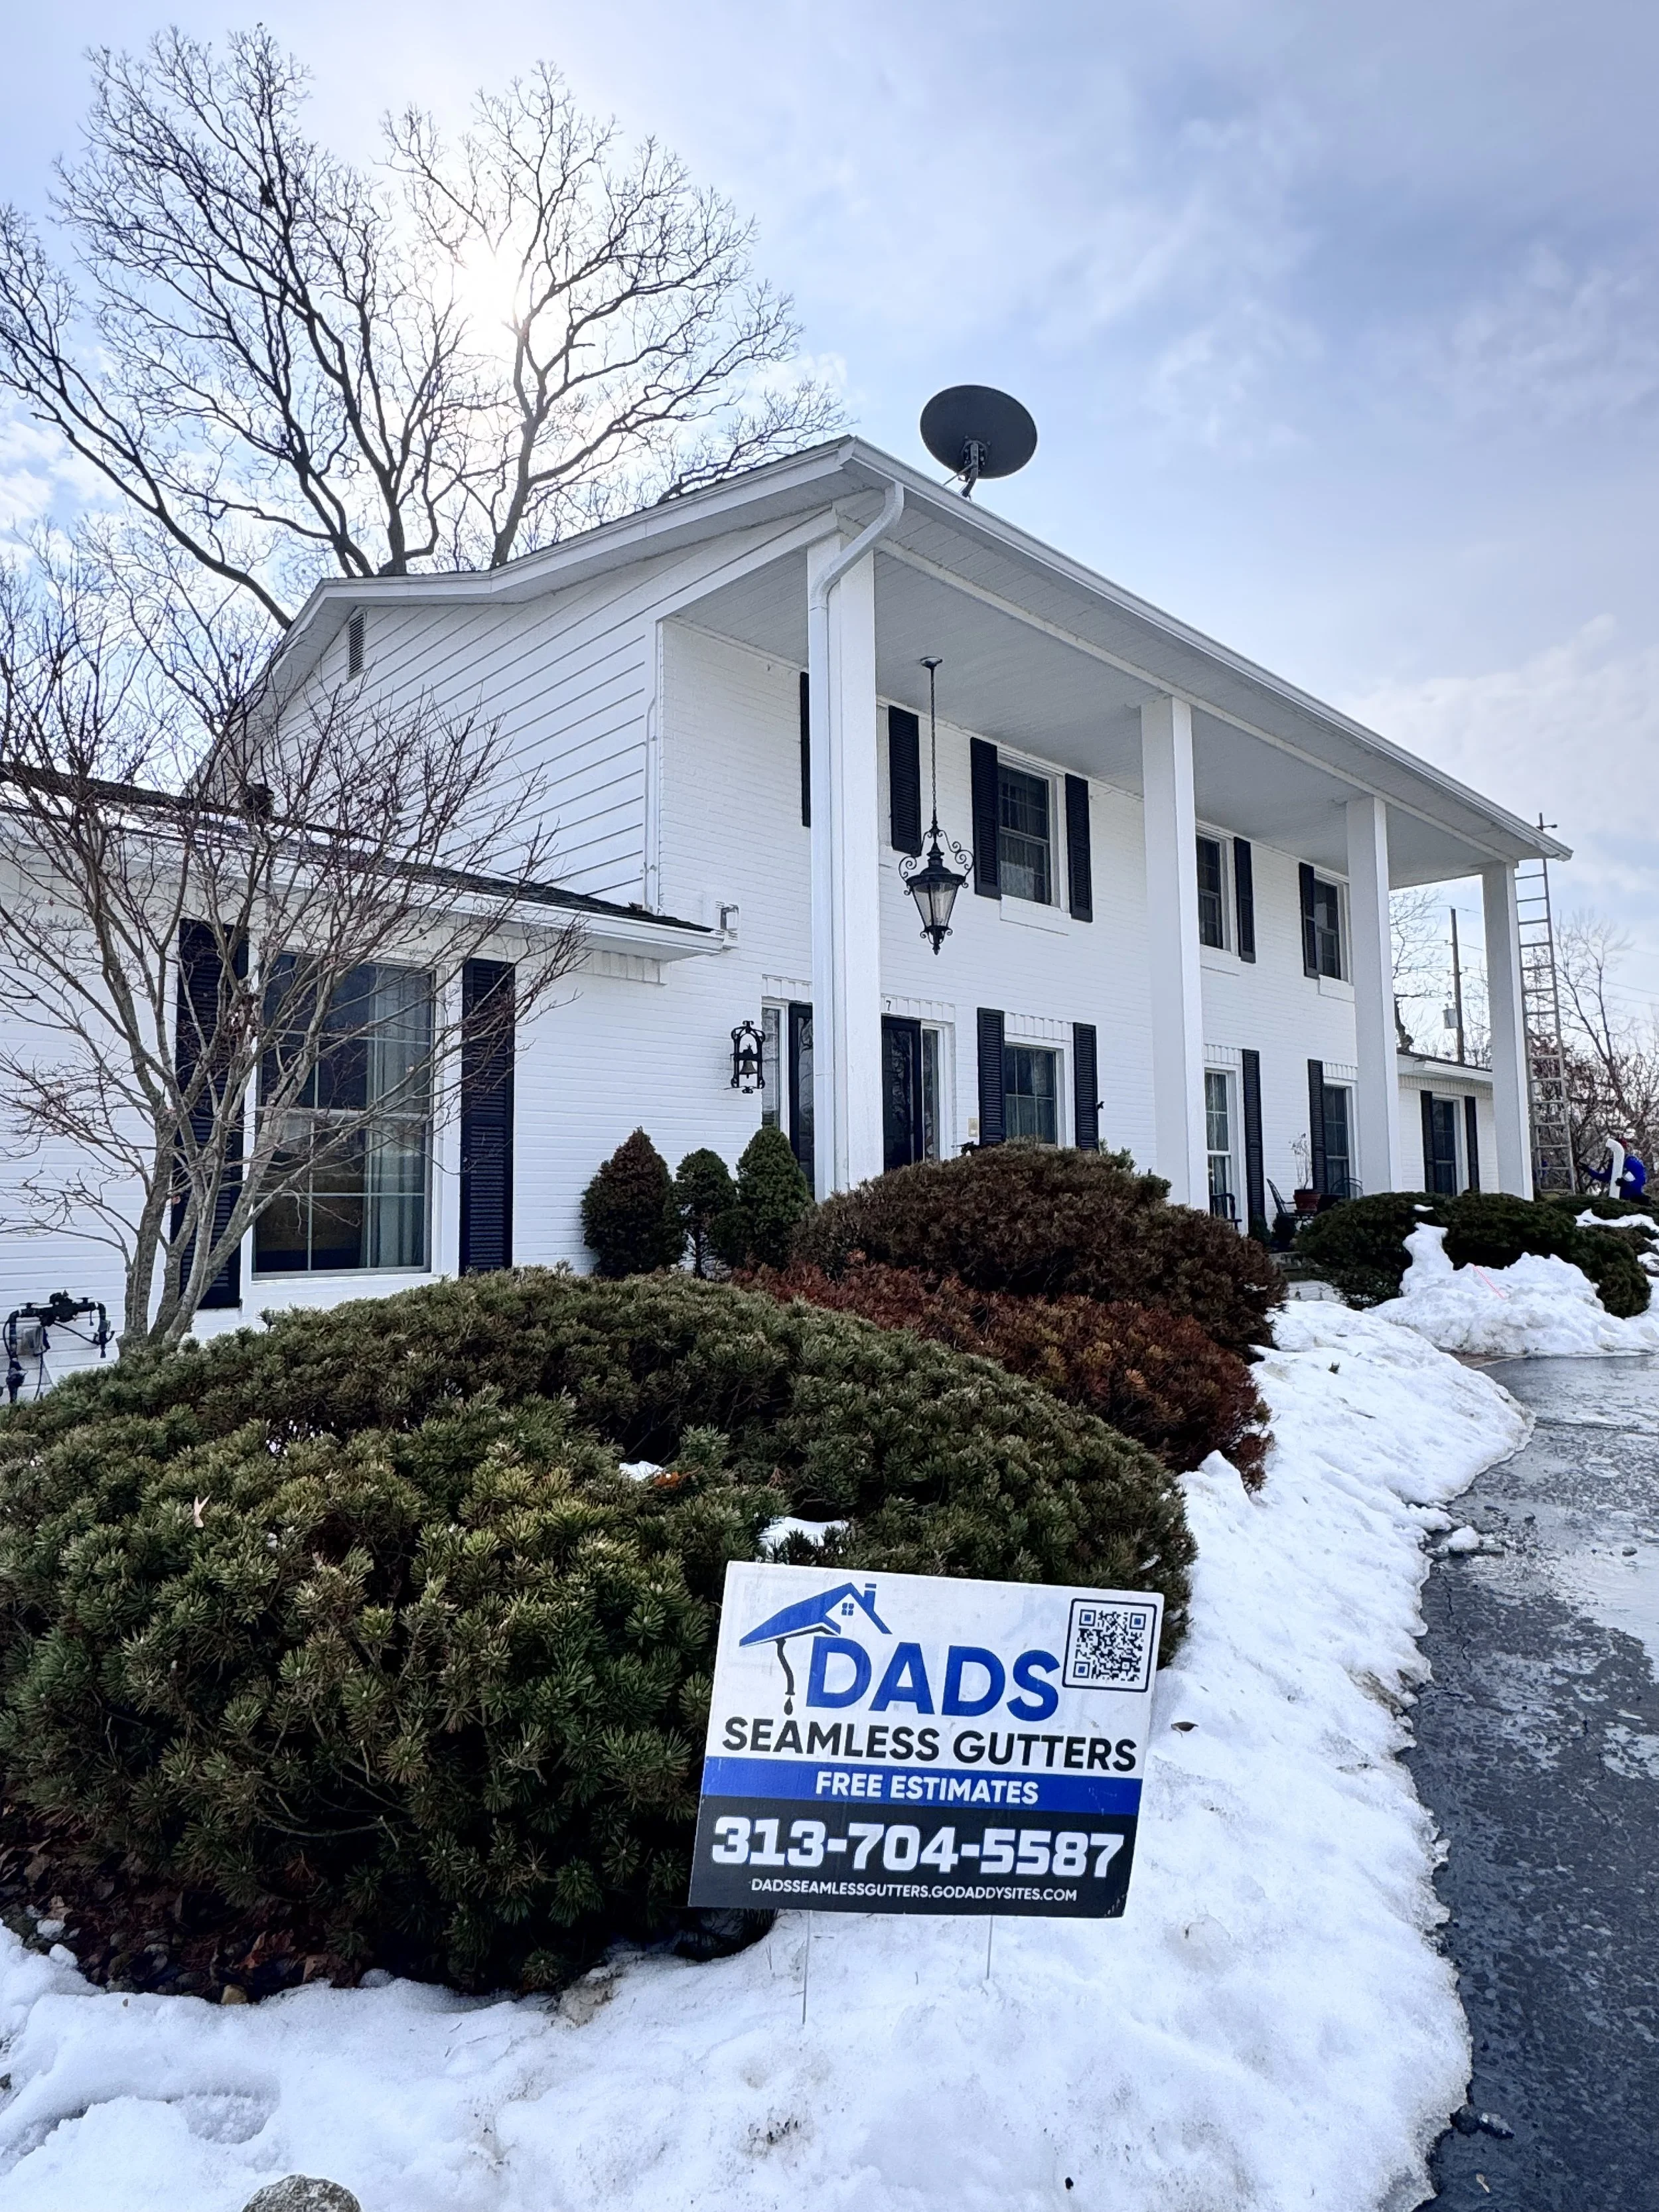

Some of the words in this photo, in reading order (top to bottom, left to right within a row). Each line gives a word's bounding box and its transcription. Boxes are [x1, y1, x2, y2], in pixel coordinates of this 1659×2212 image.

[806, 1635, 1060, 1722] DADS
[722, 1716, 940, 1761] SEAMLESS
[953, 1730, 1137, 1771] GUTTERS
[816, 1771, 883, 1797] FREE
[890, 1775, 1039, 1805] ESTIMATES
[712, 1816, 1125, 1878] 313-704-5587
[751, 1878, 1077, 1901] DADSSEAMLESSGUTTERS.GODADDYSITES.COM
